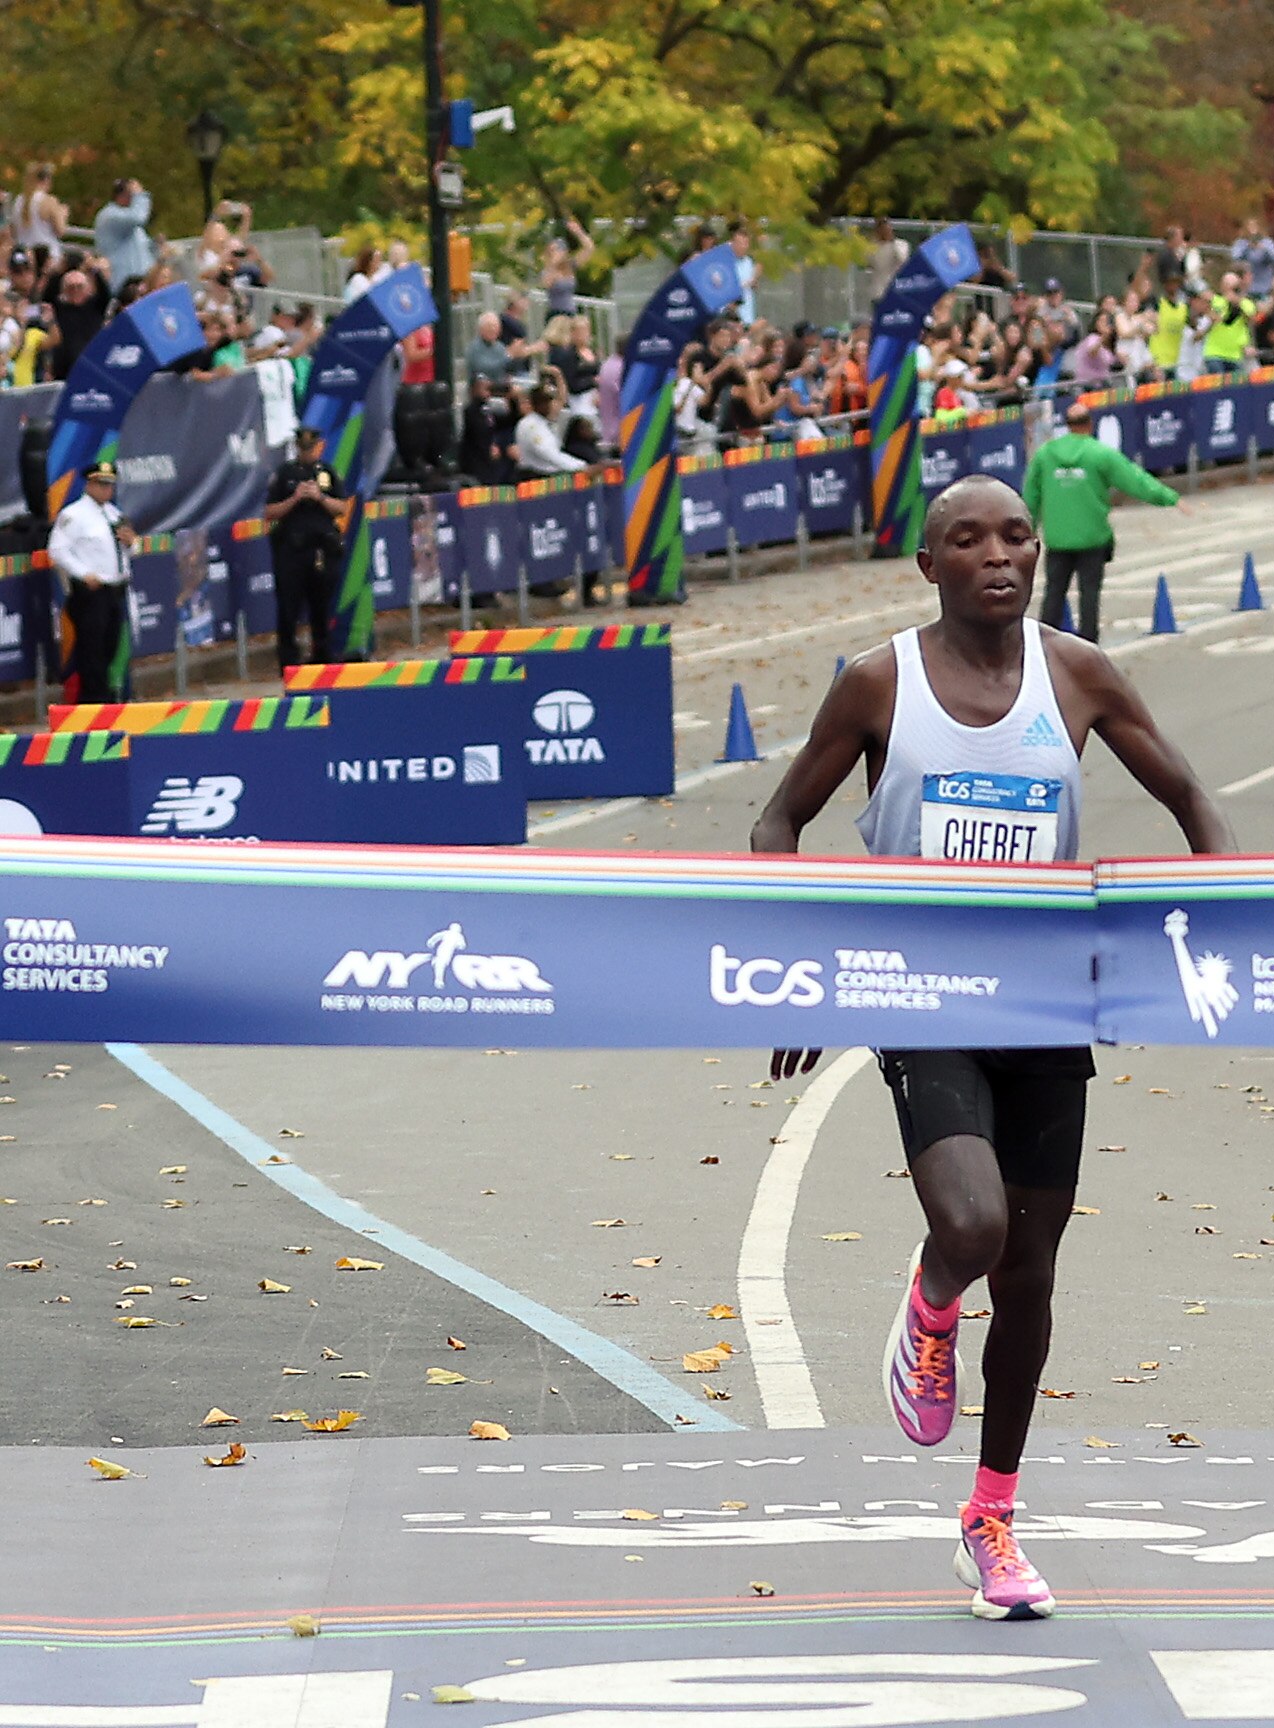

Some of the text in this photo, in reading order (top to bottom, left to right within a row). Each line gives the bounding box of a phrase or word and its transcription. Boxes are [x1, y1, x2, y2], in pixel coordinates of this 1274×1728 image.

[524, 738, 605, 763] TATA
[328, 757, 456, 782] NITED
[938, 777, 970, 800] tcs
[3, 918, 77, 943] TATA
[3, 944, 168, 969] CONSULTANCY
[834, 948, 908, 971] TATA
[3, 967, 109, 992] SERVICES
[323, 950, 555, 992] NYRR
[710, 943, 825, 1008] tcs
[834, 970, 1000, 996] CONSULTANCY
[320, 993, 556, 1016] NEW YORK ROAD RUNNERS
[834, 989, 942, 1011] SERVICES
[416, 1454, 806, 1475] MAJORS
